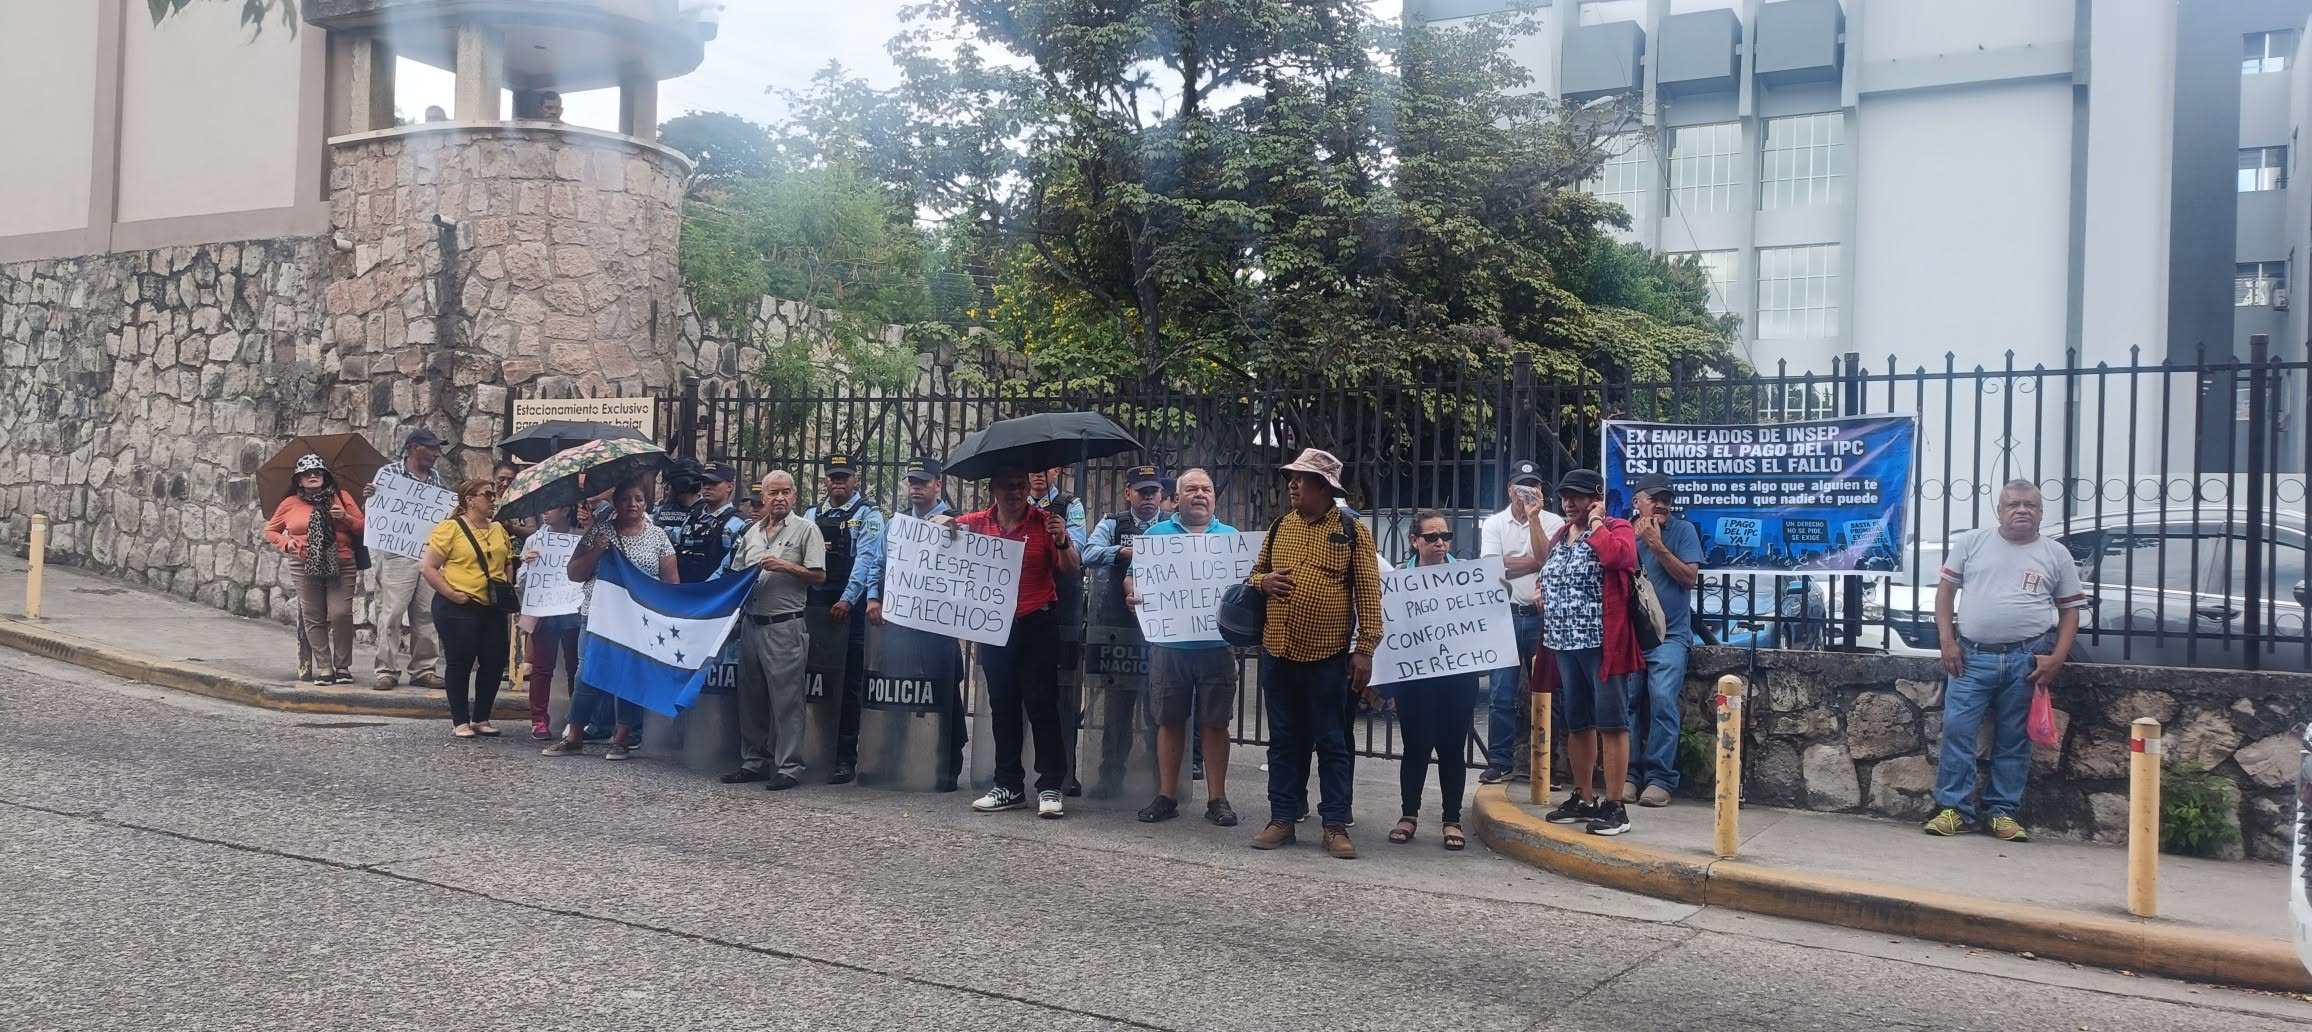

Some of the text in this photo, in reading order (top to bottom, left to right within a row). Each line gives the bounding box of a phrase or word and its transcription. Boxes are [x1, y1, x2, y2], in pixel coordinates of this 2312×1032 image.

[516, 402, 649, 415] Estacionamiento Exclusivo
[1626, 426, 1840, 444] EX EMPLEADOS DE INSEP
[1626, 440, 1864, 458] EXIGIMOS EL PAGO DEL IPC
[1625, 457, 1843, 475] CSJ QUEREMOS EL FALLO
[376, 471, 398, 491] EL
[406, 481, 432, 500] IPC
[1711, 483, 1727, 492] no
[1730, 483, 1746, 492] es
[1749, 480, 1777, 493] algo
[1781, 482, 1805, 493] que
[1811, 479, 1860, 493] alguien
[1864, 479, 1878, 490] te
[1693, 494, 1747, 505] Derecho
[1753, 495, 1777, 507] que
[1780, 493, 1815, 505] nadie
[1819, 493, 1833, 504] te
[1837, 492, 1878, 506] puede
[392, 521, 415, 535] UN
[890, 518, 1008, 560] UNIDOS POR
[1723, 527, 1759, 537] DEL IPC
[1133, 534, 1249, 556] JUSTICIA
[1730, 536, 1750, 545] YA!
[887, 540, 1011, 586] EL RESPETO
[1133, 563, 1179, 588] PARA
[1190, 560, 1228, 580] LOS
[899, 571, 1005, 605] NUESTROS
[2020, 572, 2043, 594] H
[1141, 585, 1231, 613] EMPLEA
[1405, 597, 1439, 619] PAGO
[884, 590, 1004, 633] DERECHOS
[1145, 618, 1177, 638] DE
[1386, 618, 1488, 651] CONFORME
[1439, 643, 1450, 656] A
[1396, 649, 1498, 680] DERECHO
[868, 678, 934, 704] POLICIA
